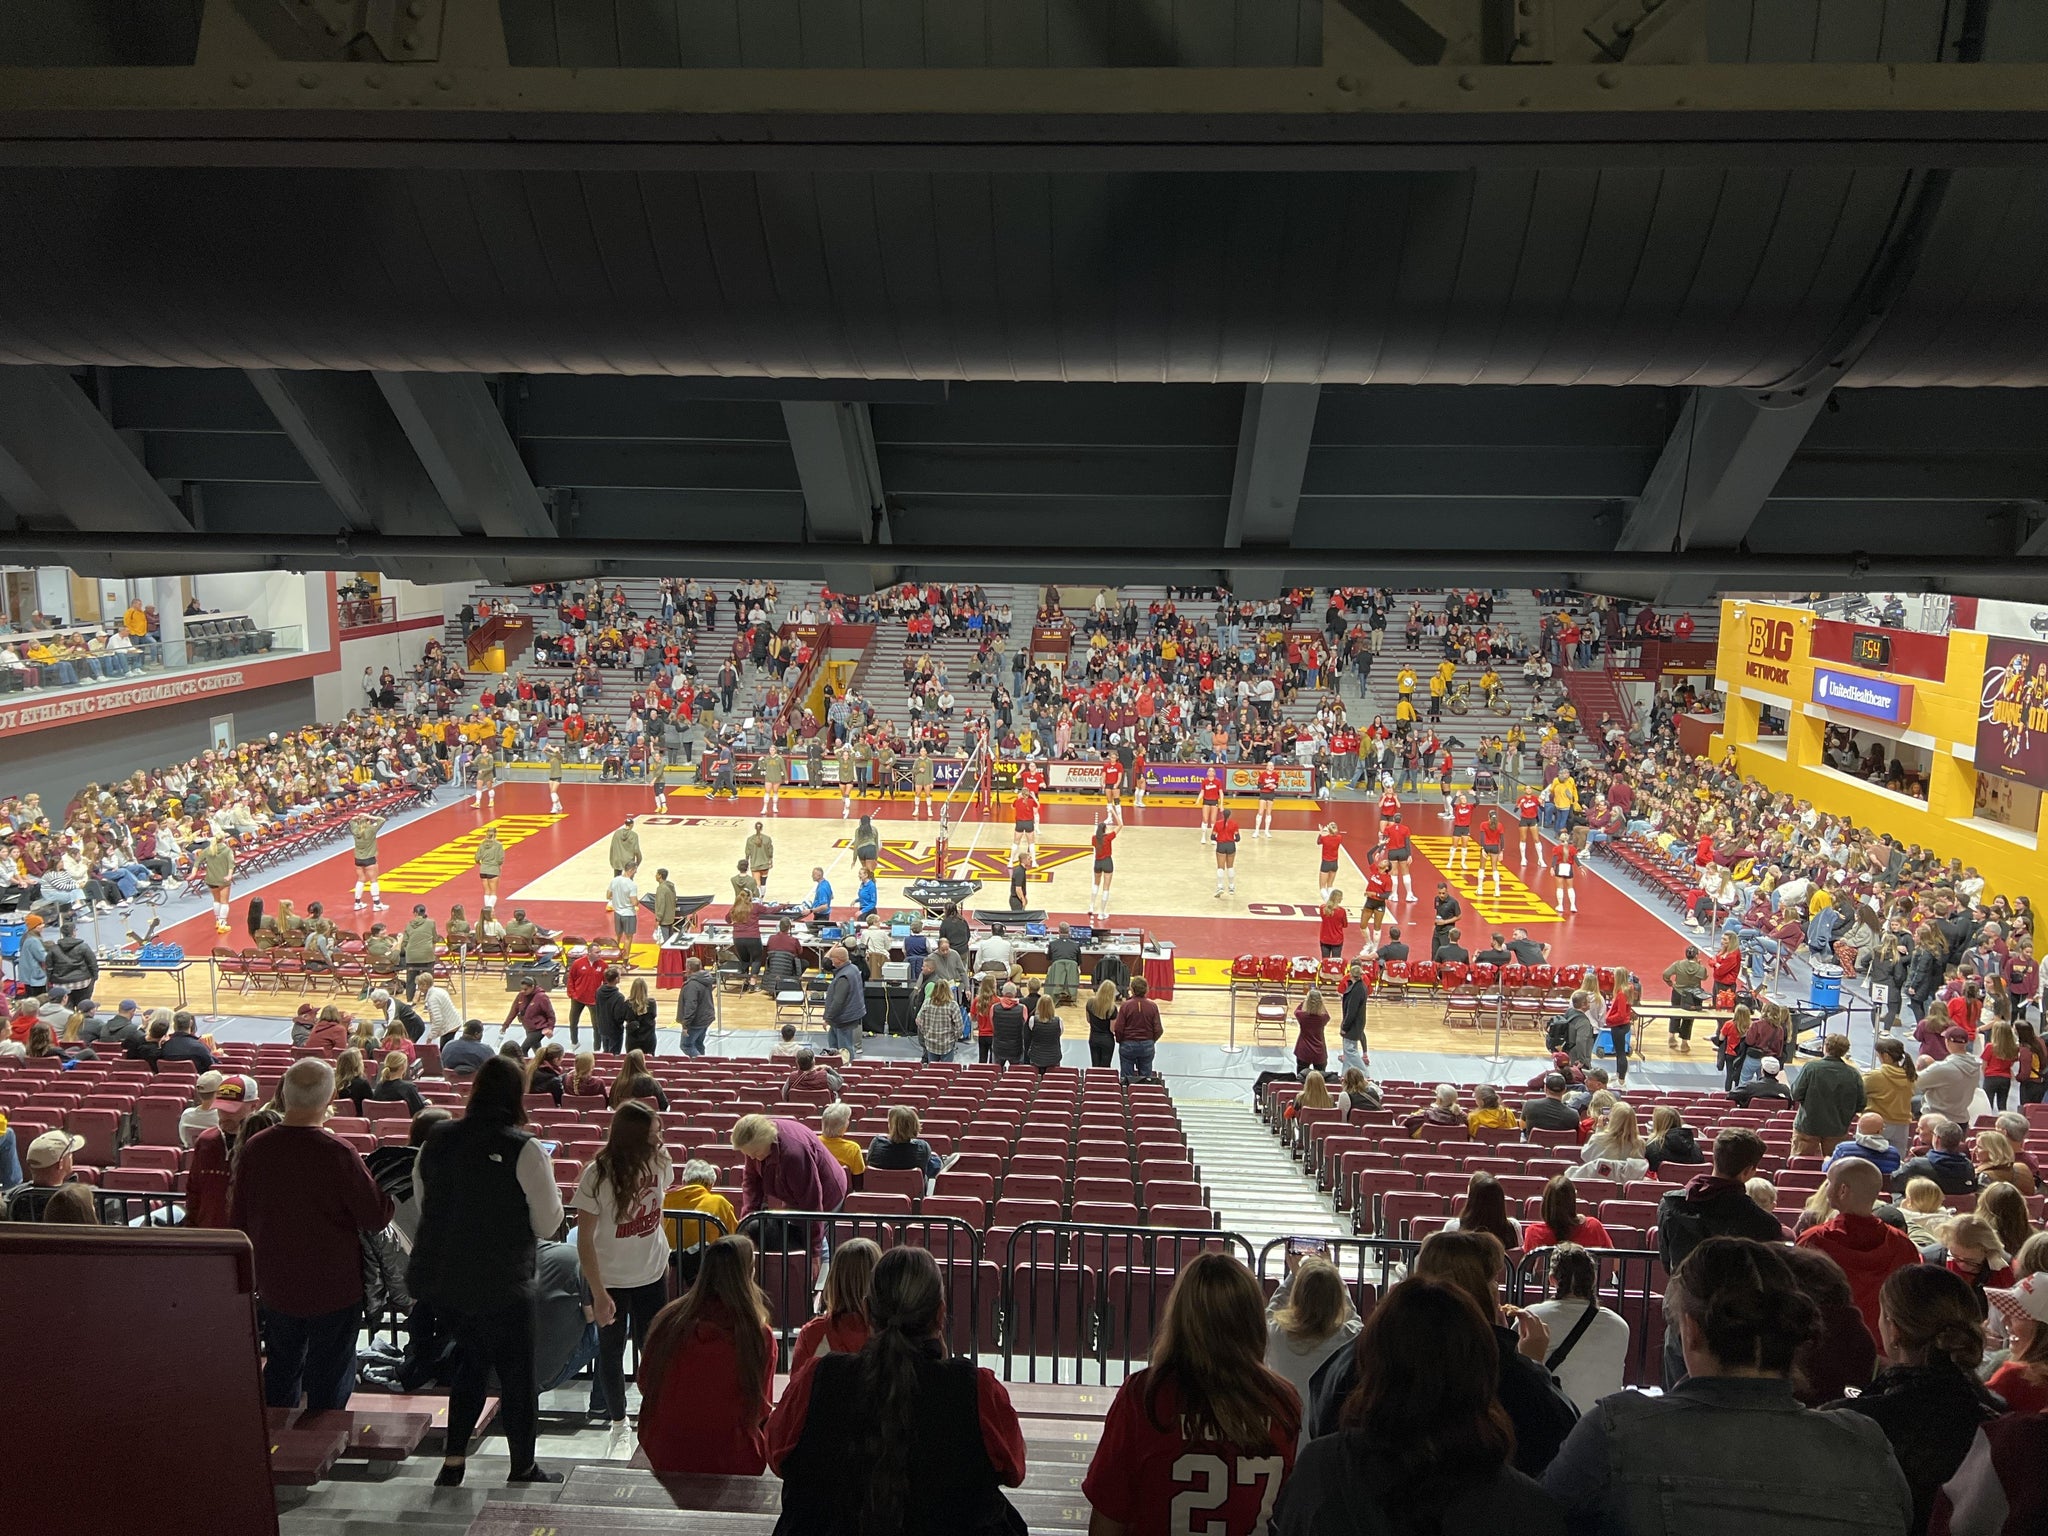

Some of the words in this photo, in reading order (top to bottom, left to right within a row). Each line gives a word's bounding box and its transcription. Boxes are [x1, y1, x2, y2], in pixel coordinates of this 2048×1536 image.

[1861, 639, 1881, 659] 1:54
[1746, 661, 1790, 686] NETWORK
[20, 697, 96, 726] ATHLETIC
[97, 679, 198, 711] PERFORMANCE
[198, 671, 245, 692] CENTER
[1829, 680, 1892, 709] UnitedHealthcare
[1992, 699, 2048, 734] MINNEOTA
[1067, 767, 1103, 777] FEDERAT
[1162, 774, 1189, 784] planet
[1190, 774, 1205, 783] fitn
[1169, 1453, 1284, 1536] 27
